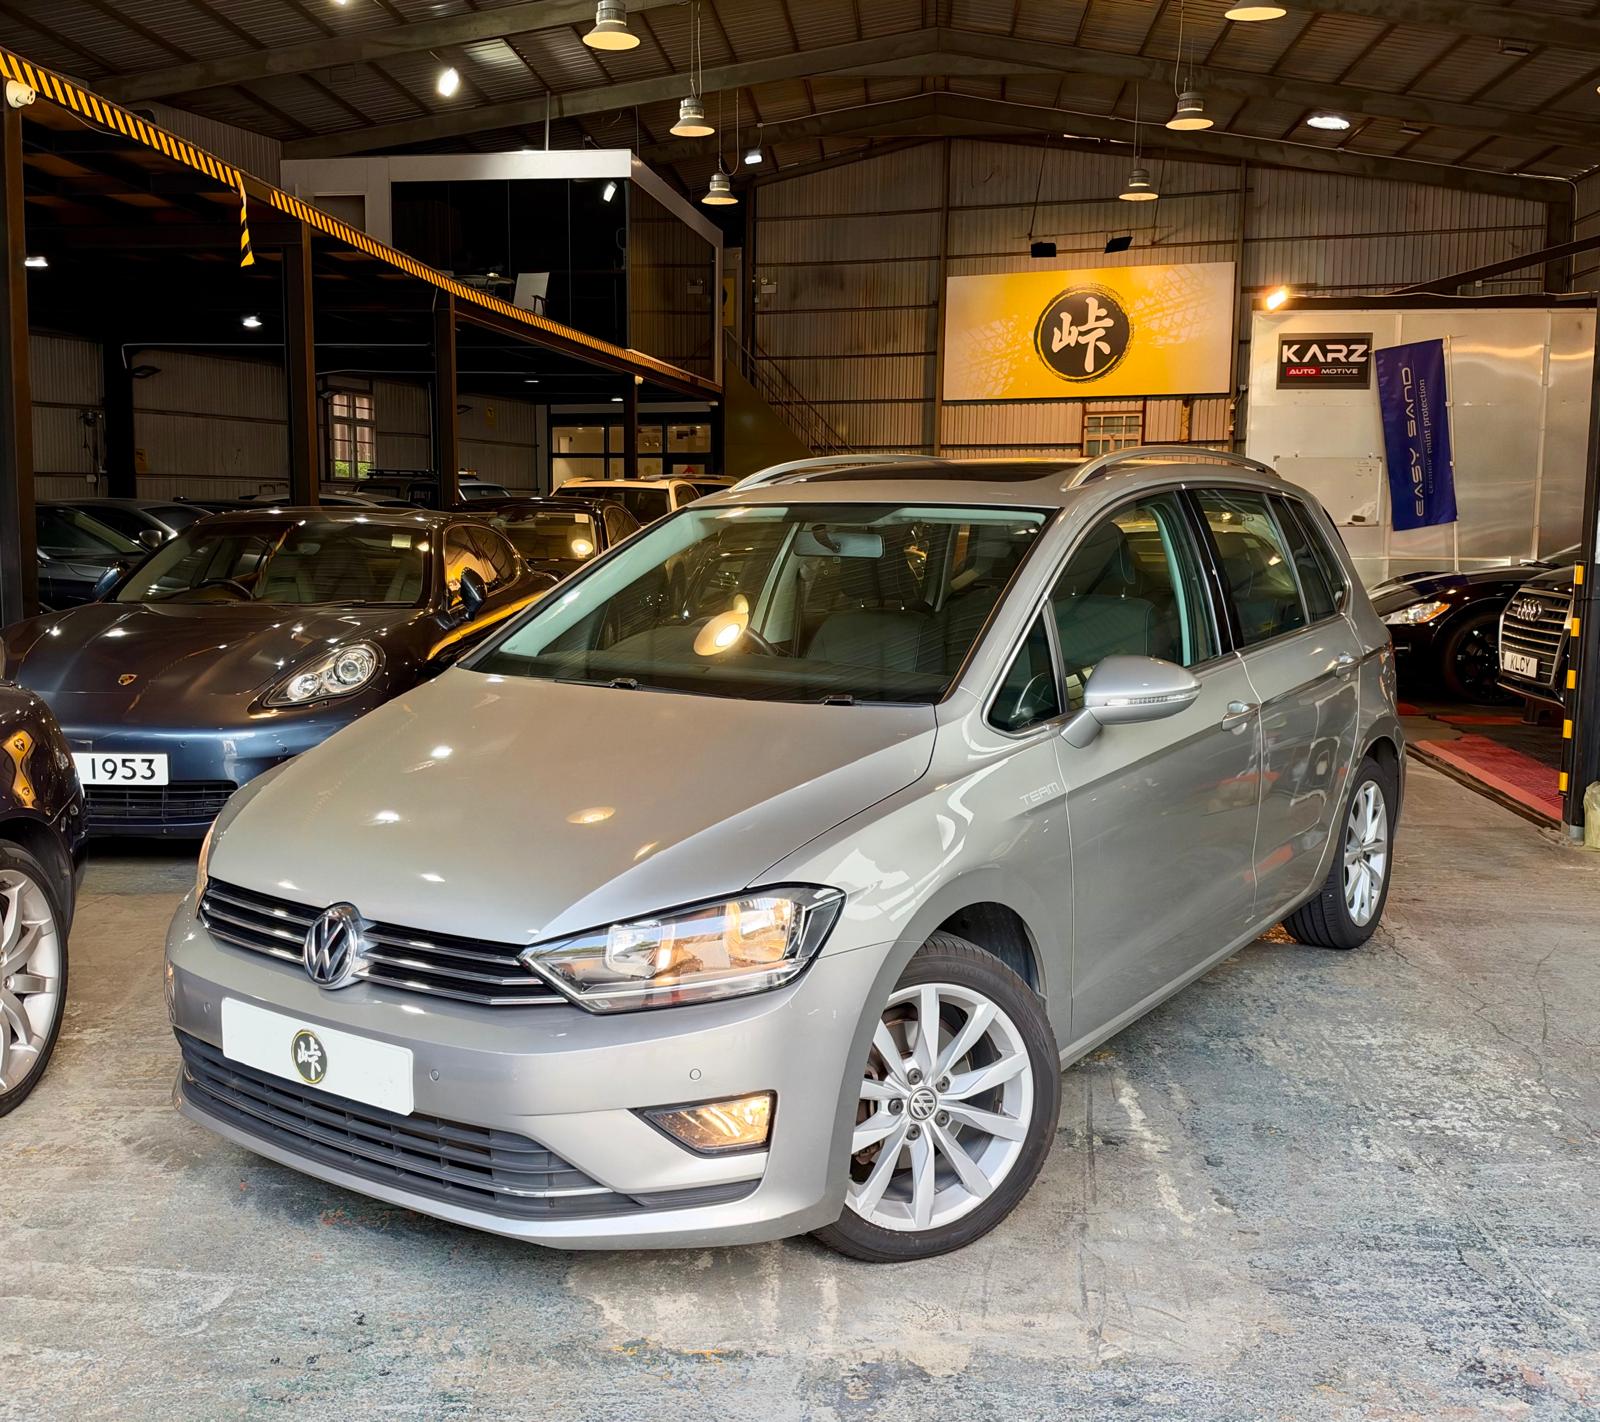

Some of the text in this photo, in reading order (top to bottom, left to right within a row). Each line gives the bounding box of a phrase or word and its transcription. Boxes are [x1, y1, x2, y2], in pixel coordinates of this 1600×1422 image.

[1051, 296, 1115, 373] 峠
[1281, 343, 1368, 363] KARZ
[1418, 378, 1431, 427] protection
[1401, 367, 1425, 517] EASY SAND
[91, 757, 156, 781] 1953
[1019, 781, 1060, 806] TEAM
[296, 1035, 323, 1081] 峠
